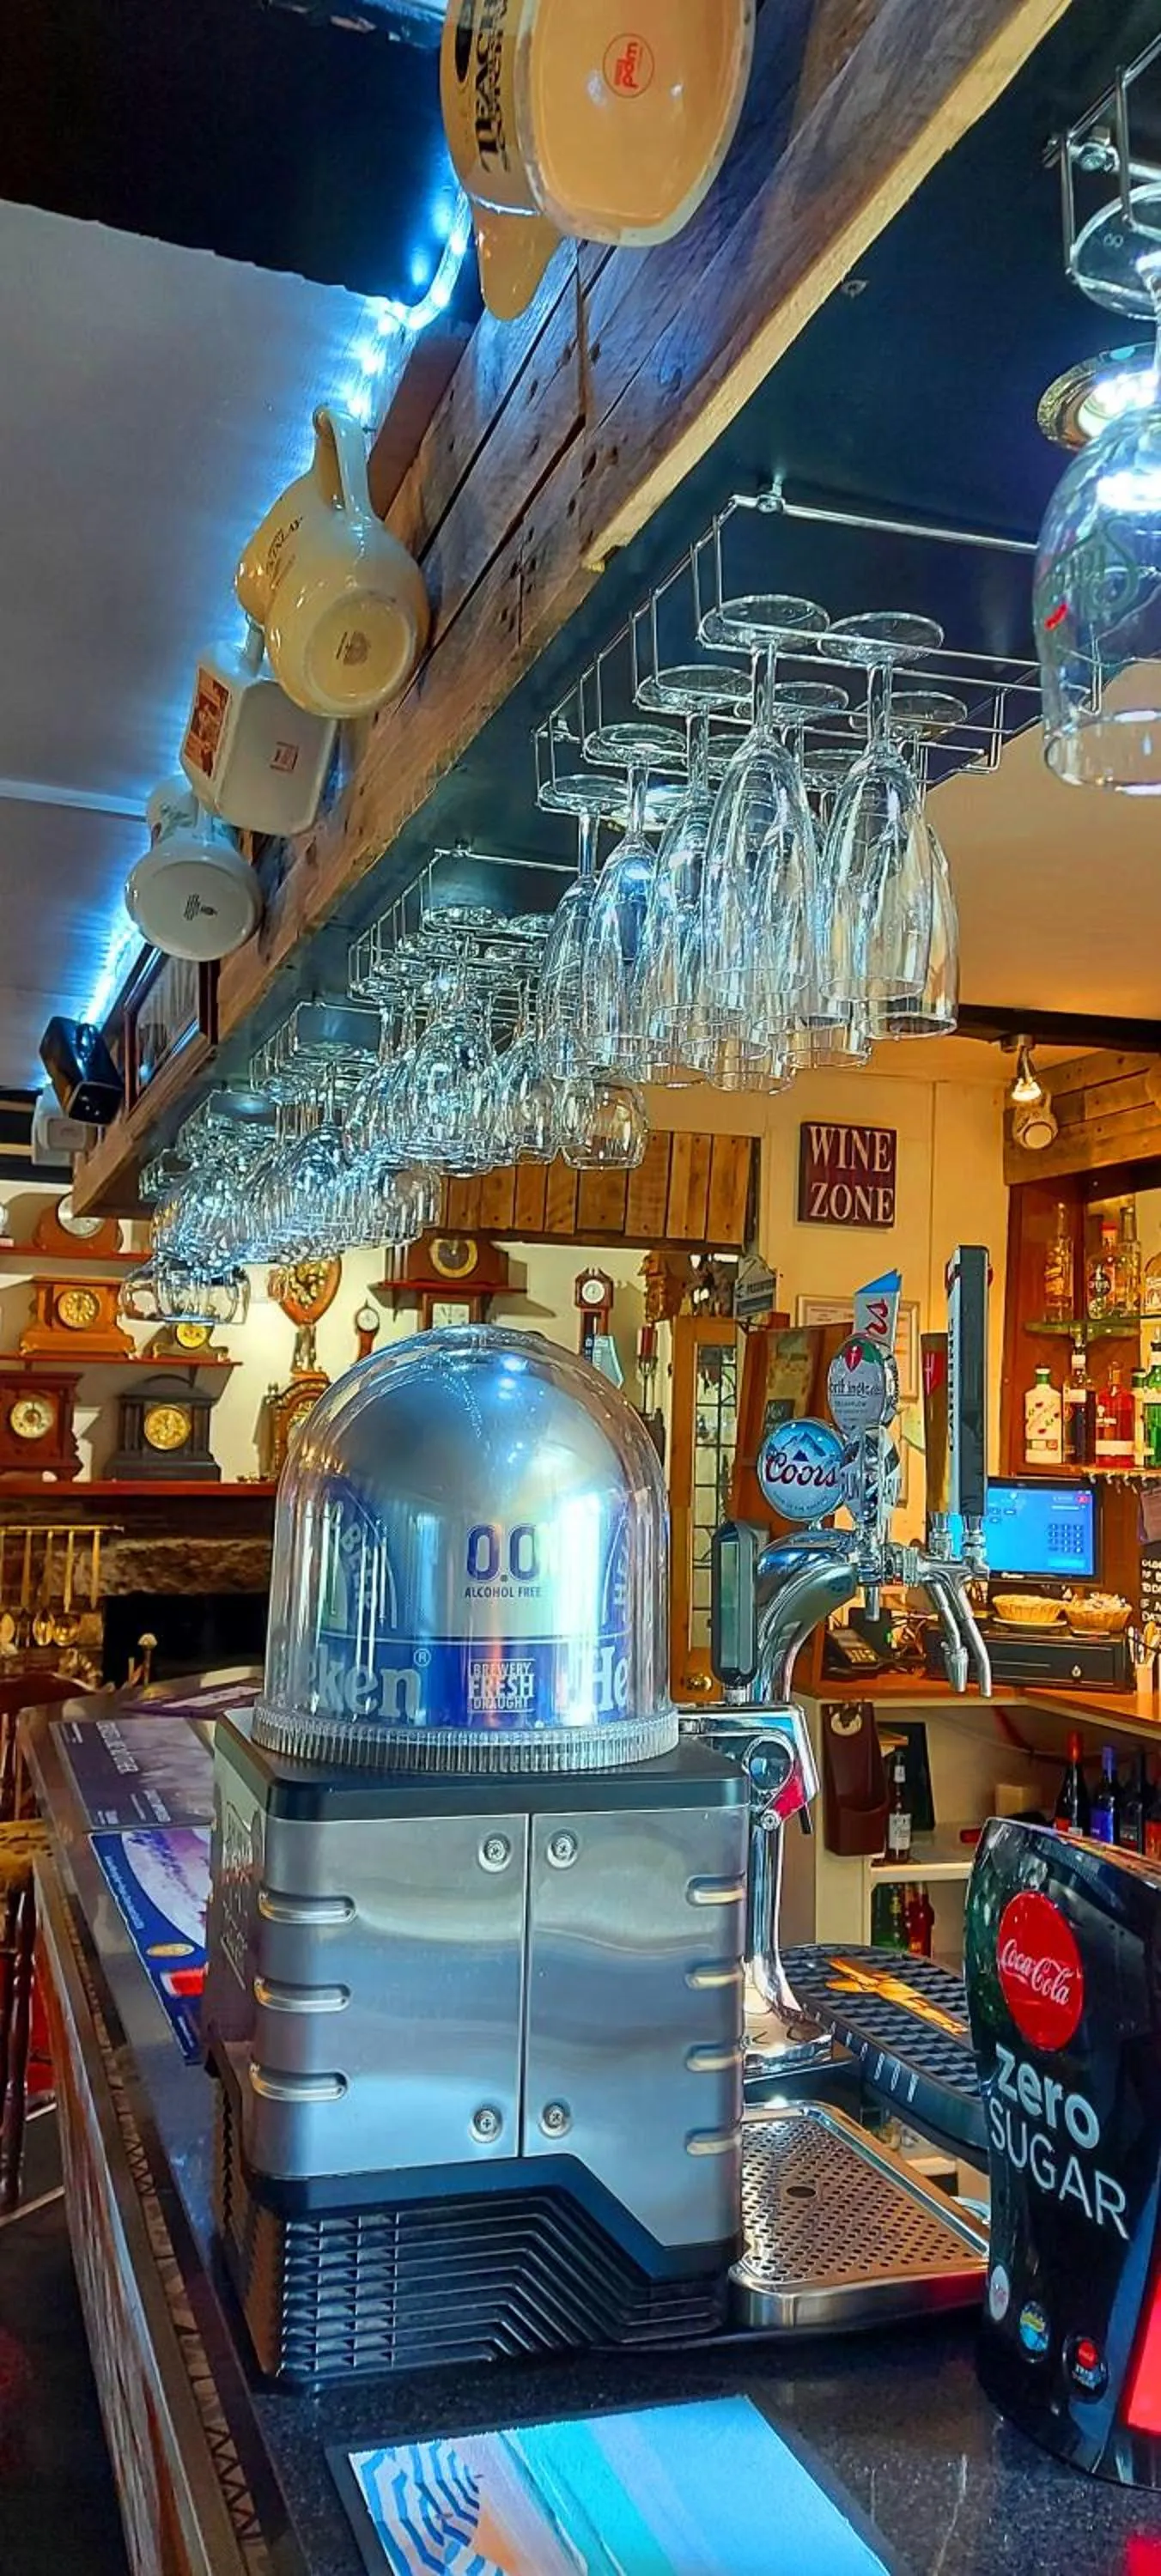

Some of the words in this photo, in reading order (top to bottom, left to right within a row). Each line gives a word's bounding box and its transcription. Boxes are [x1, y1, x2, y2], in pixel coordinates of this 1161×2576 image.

[810, 1126, 892, 1172] WINE
[810, 1182, 894, 1222] ZONE
[765, 1452, 838, 1487] Coors
[466, 1524, 540, 1583] 0.0
[465, 1586, 514, 1598] ALCOHOL
[468, 1674, 534, 1698] FRESH
[1001, 1939, 1073, 2006] Coca-Cola
[996, 2042, 1100, 2149] zero
[989, 2096, 1129, 2240] SUGAR
